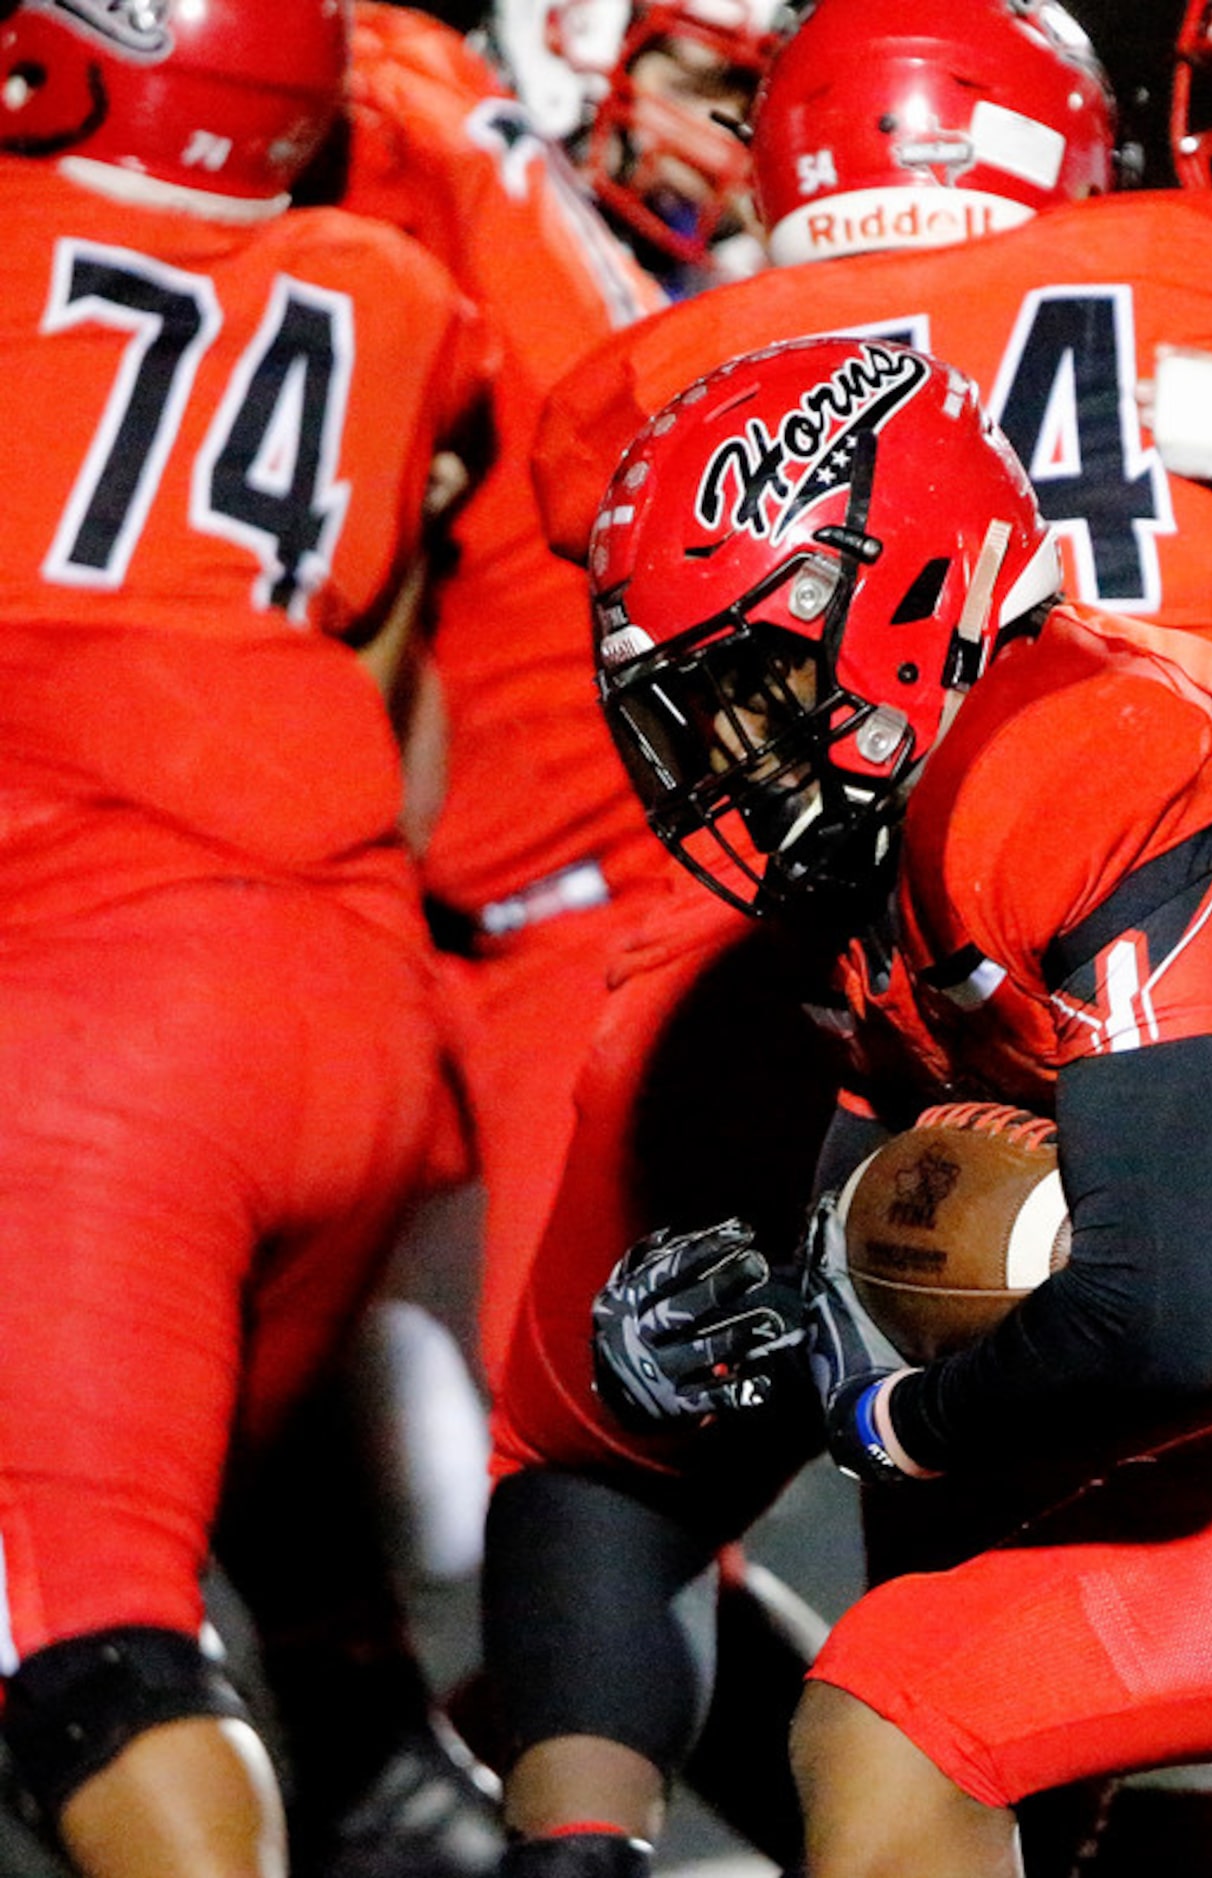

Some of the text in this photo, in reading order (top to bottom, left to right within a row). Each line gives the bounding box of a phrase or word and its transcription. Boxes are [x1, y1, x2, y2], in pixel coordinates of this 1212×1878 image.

[797, 149, 838, 194] 54
[807, 203, 994, 246] Riddell
[42, 238, 353, 626] 74
[696, 343, 928, 542] Horns
